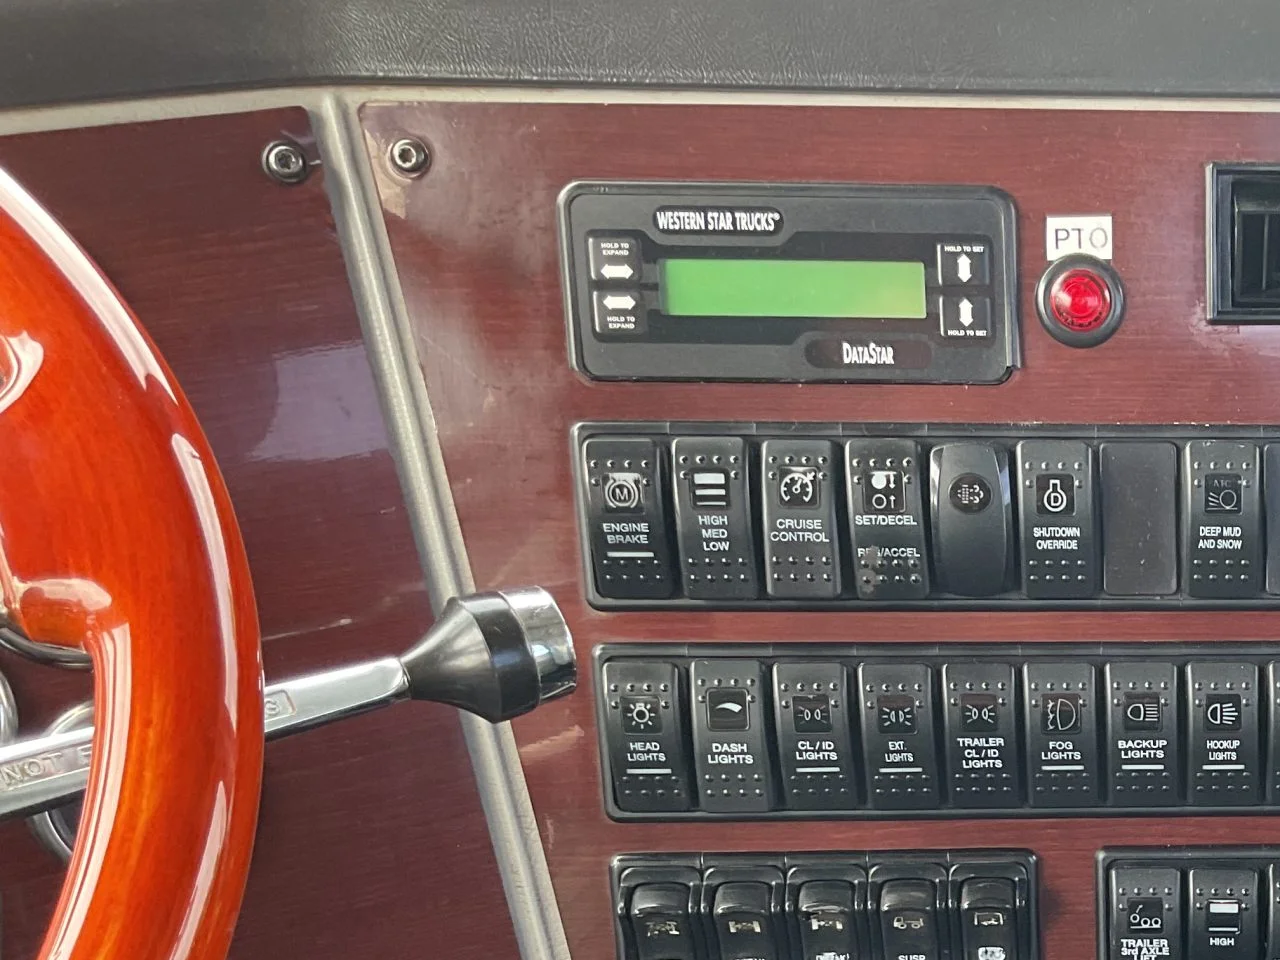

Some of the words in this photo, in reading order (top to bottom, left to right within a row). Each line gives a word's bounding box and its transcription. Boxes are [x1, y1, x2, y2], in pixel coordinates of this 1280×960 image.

[656, 211, 705, 230] WESTERN
[707, 212, 734, 231] STAR
[1054, 227, 1108, 249] PTO
[698, 515, 728, 526] HIGH
[776, 518, 822, 530] CRUISE
[854, 514, 918, 526] SET/DECEL
[602, 522, 650, 533] ENGINE
[1033, 527, 1081, 538] SHUTDOWN
[1199, 526, 1221, 537] DEEP
[1222, 527, 1242, 537] MUD
[702, 528, 728, 539] MED
[770, 531, 830, 542] CONTROL
[606, 534, 649, 544] BRAKE
[703, 541, 730, 551] LOW
[1036, 539, 1078, 550] OVERRIDE
[1198, 539, 1216, 550] AND
[1216, 539, 1243, 550] SNOW
[857, 547, 921, 558] R/ACCEL
[629, 742, 660, 751] HEAD
[797, 741, 814, 750] CL
[821, 741, 835, 750] ID
[888, 741, 907, 750] EXT.
[956, 737, 1005, 747] TRAILER
[1049, 741, 1073, 750] FOG
[1117, 739, 1168, 749] BACKUP
[1206, 739, 1240, 750] HOOKUP
[711, 742, 748, 753] DASH
[626, 752, 667, 762] LIGHTS
[795, 751, 838, 761] LIGHTS
[884, 752, 914, 763] LIGHTS
[964, 748, 980, 758] CL
[987, 749, 999, 758] ID
[1041, 751, 1082, 760] LIGHTS
[1121, 749, 1165, 759] LIGHTS
[1208, 751, 1237, 761] LIGHTS
[707, 754, 754, 765] LIGHTS
[962, 759, 1003, 769] LIGHTS
[0, 752, 62, 786] NOT
[1120, 938, 1169, 948] TRAILER
[1209, 937, 1235, 946] HIGH
[1120, 947, 1139, 956] 3rd
[1140, 947, 1170, 956] AXLE
